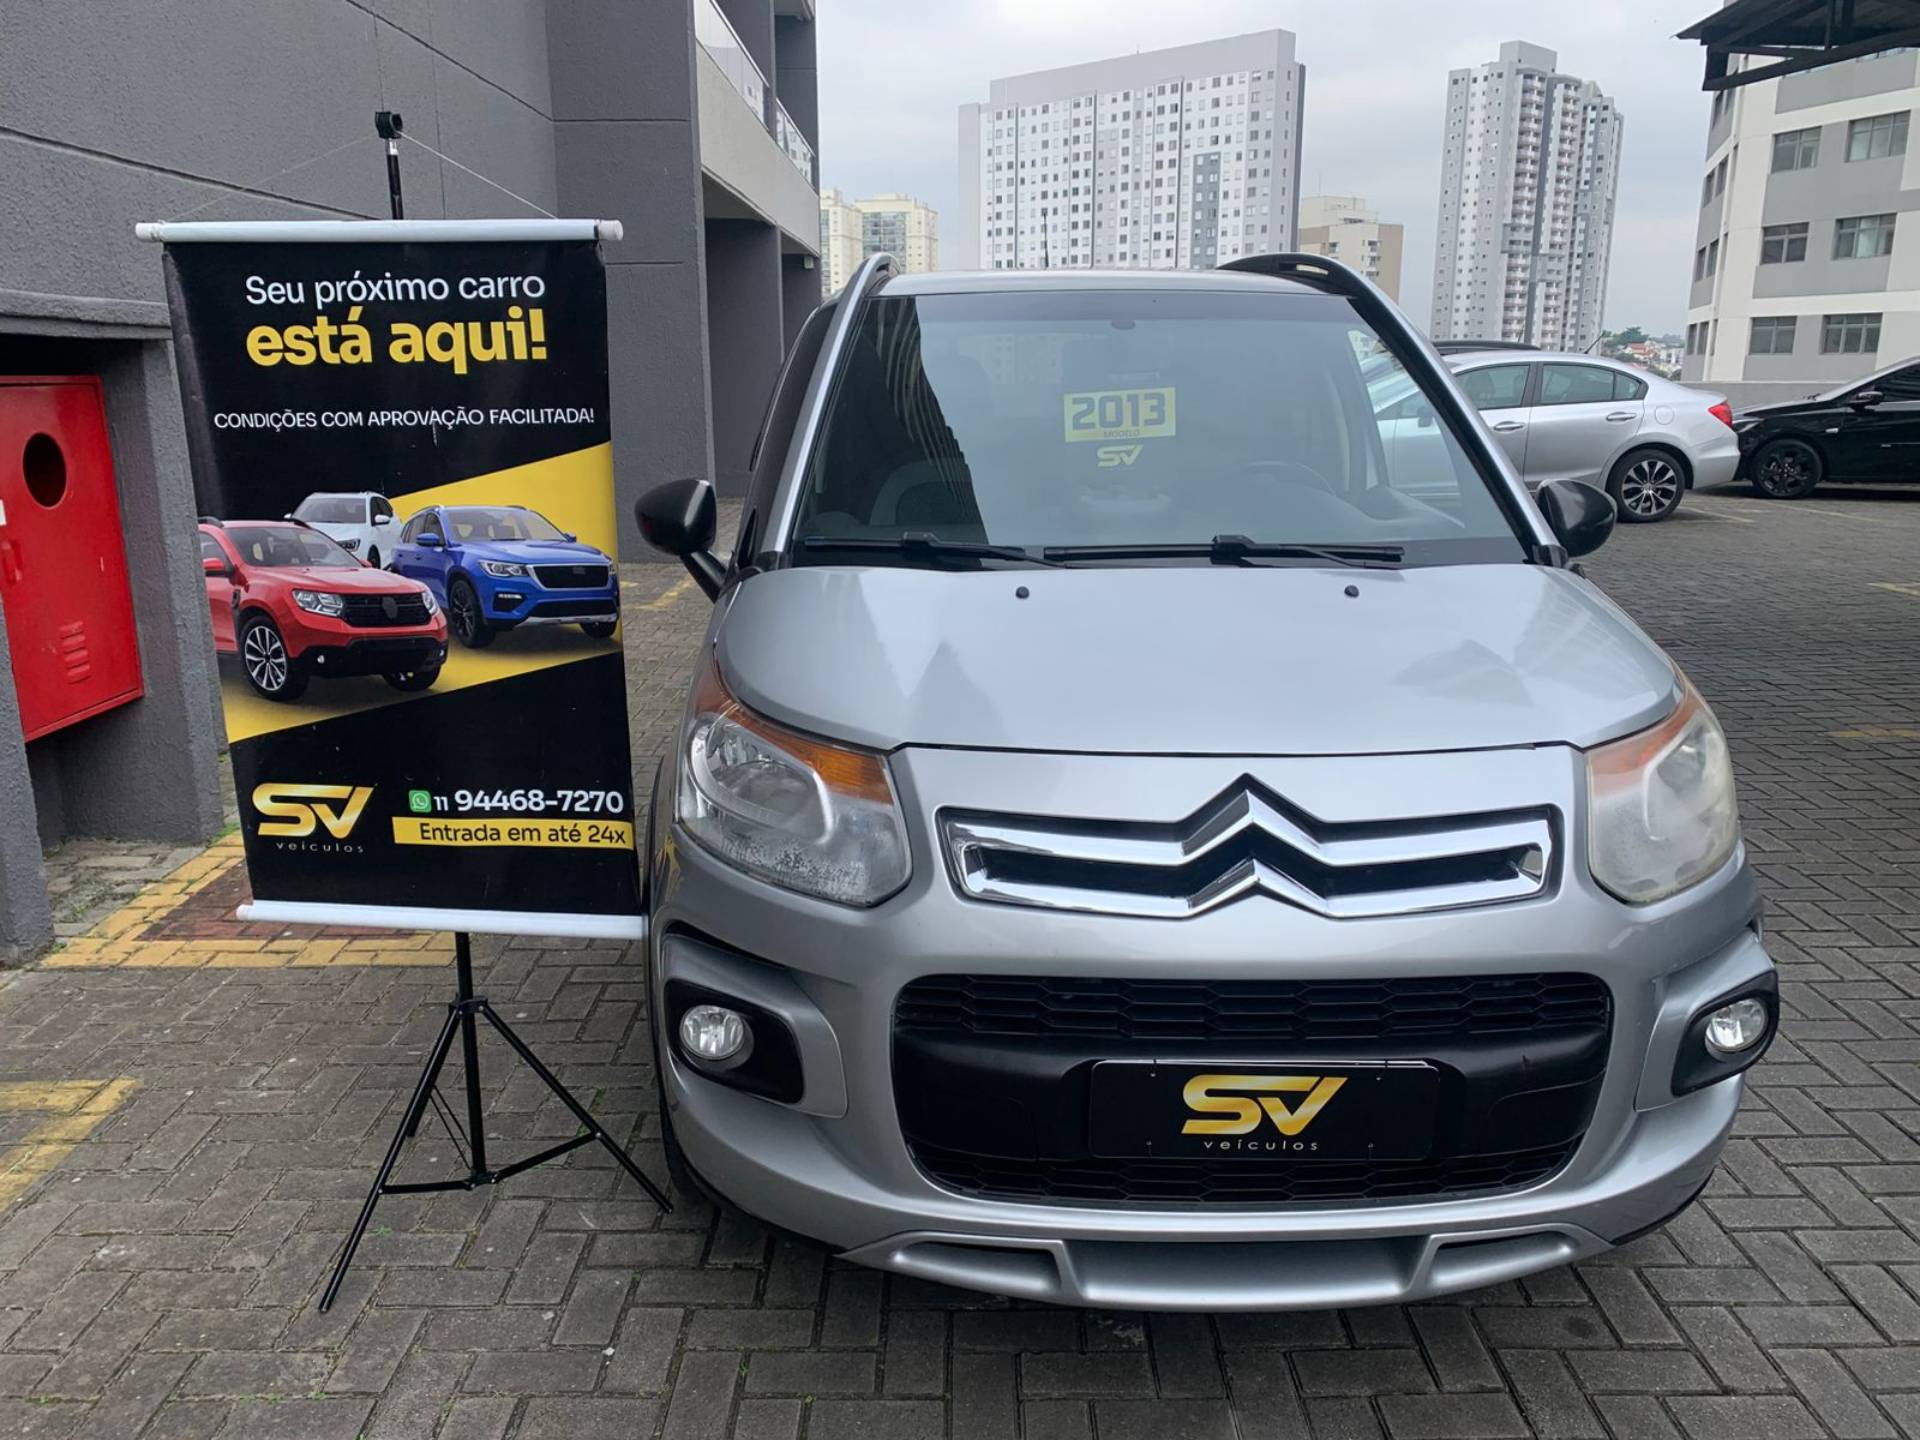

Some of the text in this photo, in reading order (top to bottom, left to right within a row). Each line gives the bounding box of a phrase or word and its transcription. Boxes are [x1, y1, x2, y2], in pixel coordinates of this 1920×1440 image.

[246, 270, 546, 309] Seu próximo carro
[246, 305, 547, 375] está aqui!
[213, 406, 595, 432] CONDIÇÕES COM APROVAÇÃO FACILITADA!
[1072, 393, 1166, 430] 2013
[1103, 429, 1141, 439] MODELO
[1096, 444, 1144, 468] SV
[252, 782, 374, 839] SV
[433, 789, 624, 813] 11 94468-7270
[419, 822, 626, 844] Entrada em até 24x
[1181, 1074, 1348, 1136] SV
[1203, 1138, 1319, 1151] veículos
